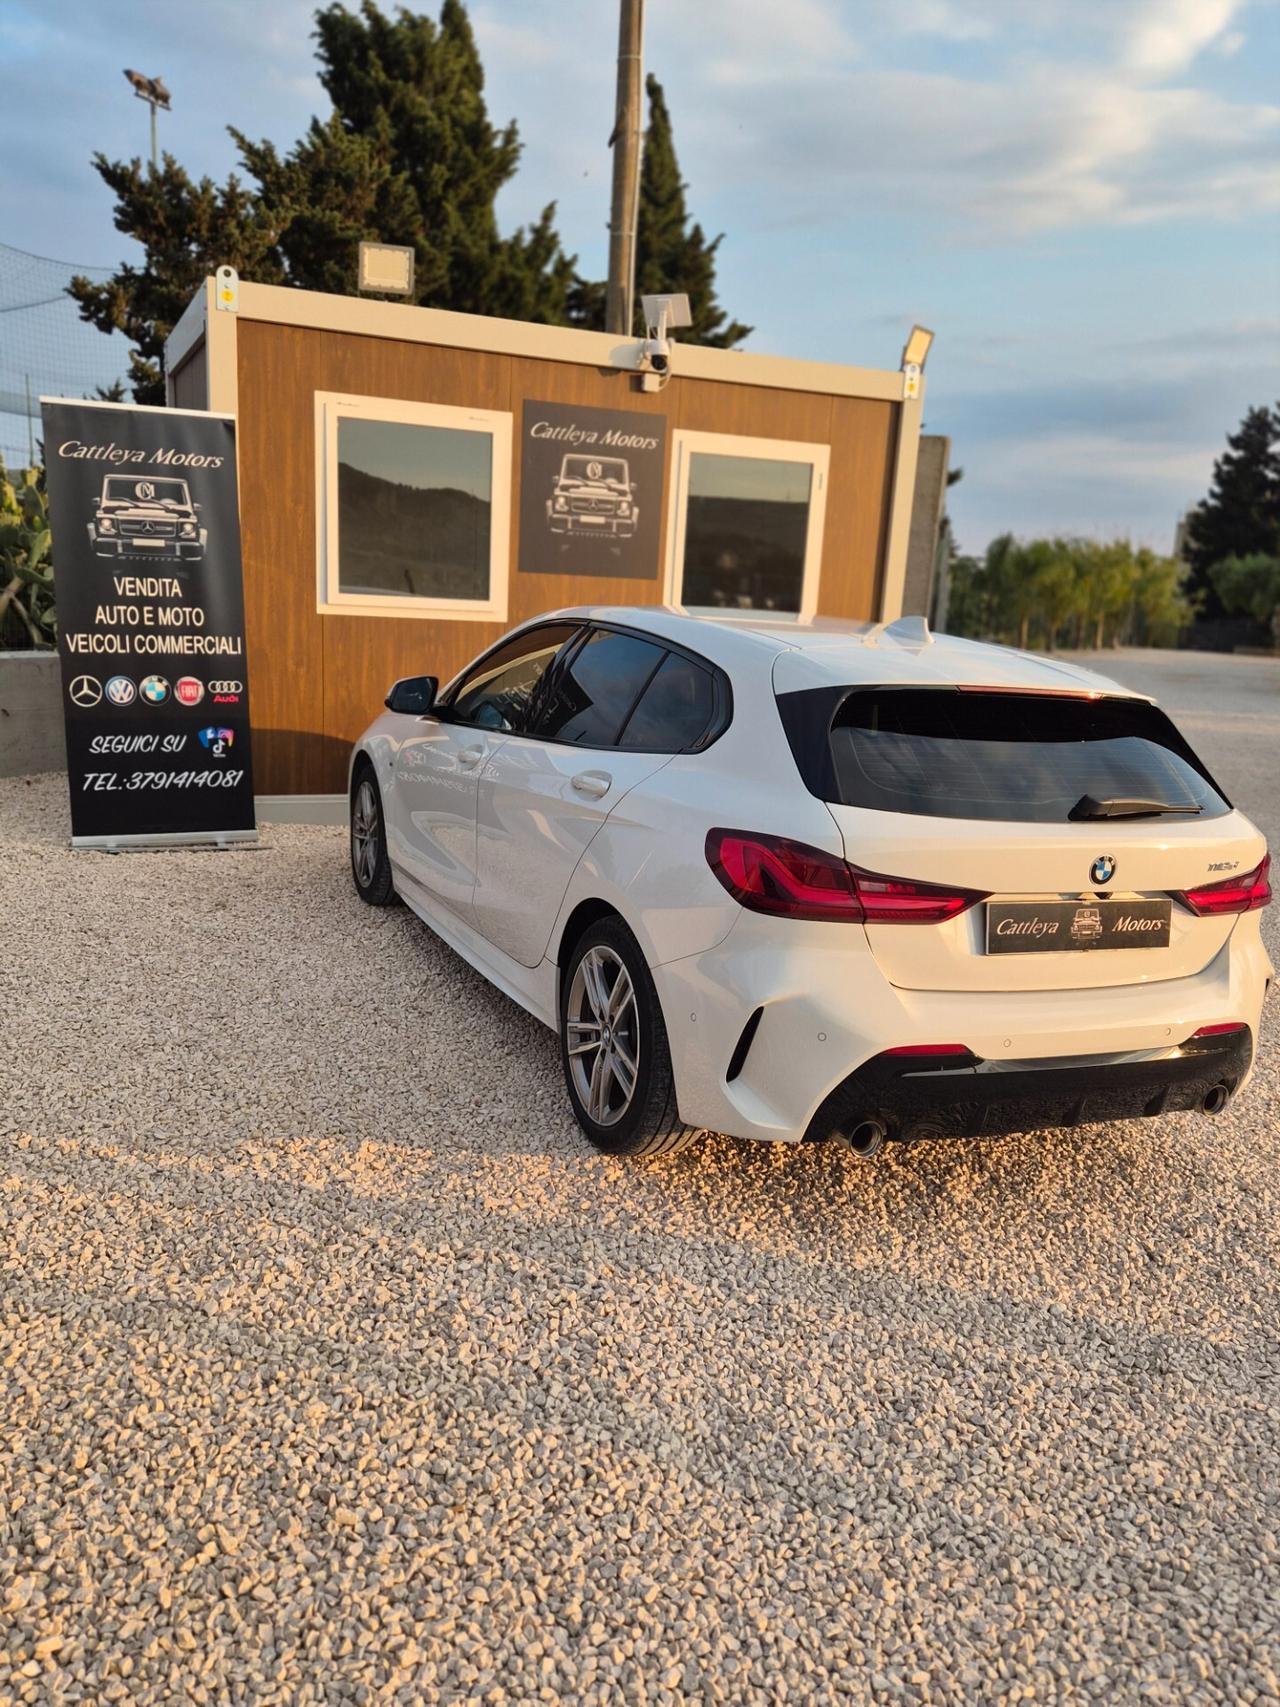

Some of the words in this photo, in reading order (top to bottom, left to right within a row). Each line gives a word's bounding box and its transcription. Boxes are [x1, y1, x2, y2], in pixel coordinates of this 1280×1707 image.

[530, 421, 598, 446] Cattleya
[600, 430, 659, 450] Motors
[58, 440, 146, 465] Cattleya
[148, 448, 224, 468] Motors
[113, 576, 182, 598] VENDITA
[95, 605, 140, 625] AUTO
[143, 606, 154, 625] E
[158, 607, 205, 627] MOTO
[66, 633, 130, 654] VEICOLI
[134, 635, 242, 655] COMMERCIALI
[213, 695, 239, 703] Audi
[89, 735, 160, 754] SEGUICI
[161, 735, 187, 752] SU
[996, 919, 1060, 939] Cattleya
[1111, 916, 1164, 933] Motors
